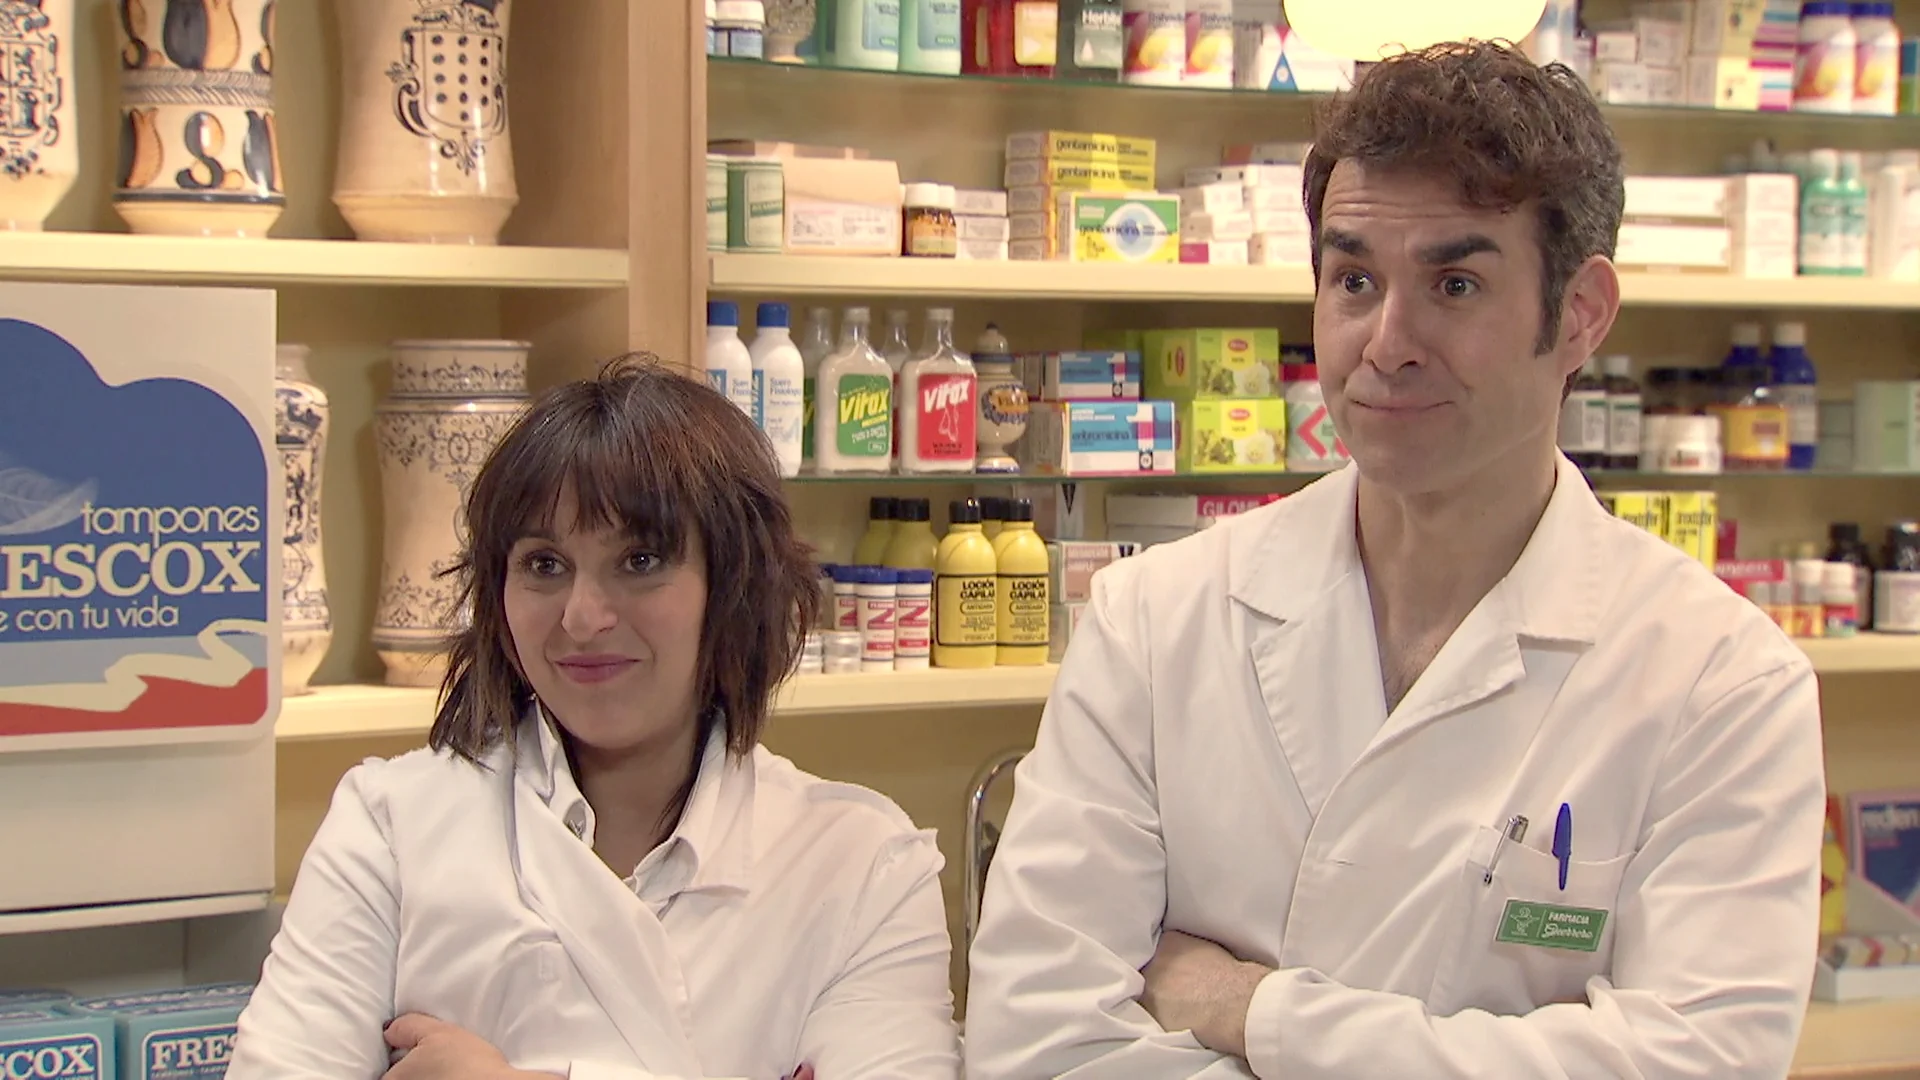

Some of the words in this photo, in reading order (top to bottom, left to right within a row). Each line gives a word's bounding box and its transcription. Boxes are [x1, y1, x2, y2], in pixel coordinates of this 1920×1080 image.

[80, 501, 261, 549] tampones
[15, 608, 75, 633] con
[80, 602, 110, 630] tu
[115, 594, 180, 628] vida
[1548, 911, 1590, 925] FARMACIA
[0, 1043, 96, 1080] COX
[151, 1034, 237, 1071] FRE
